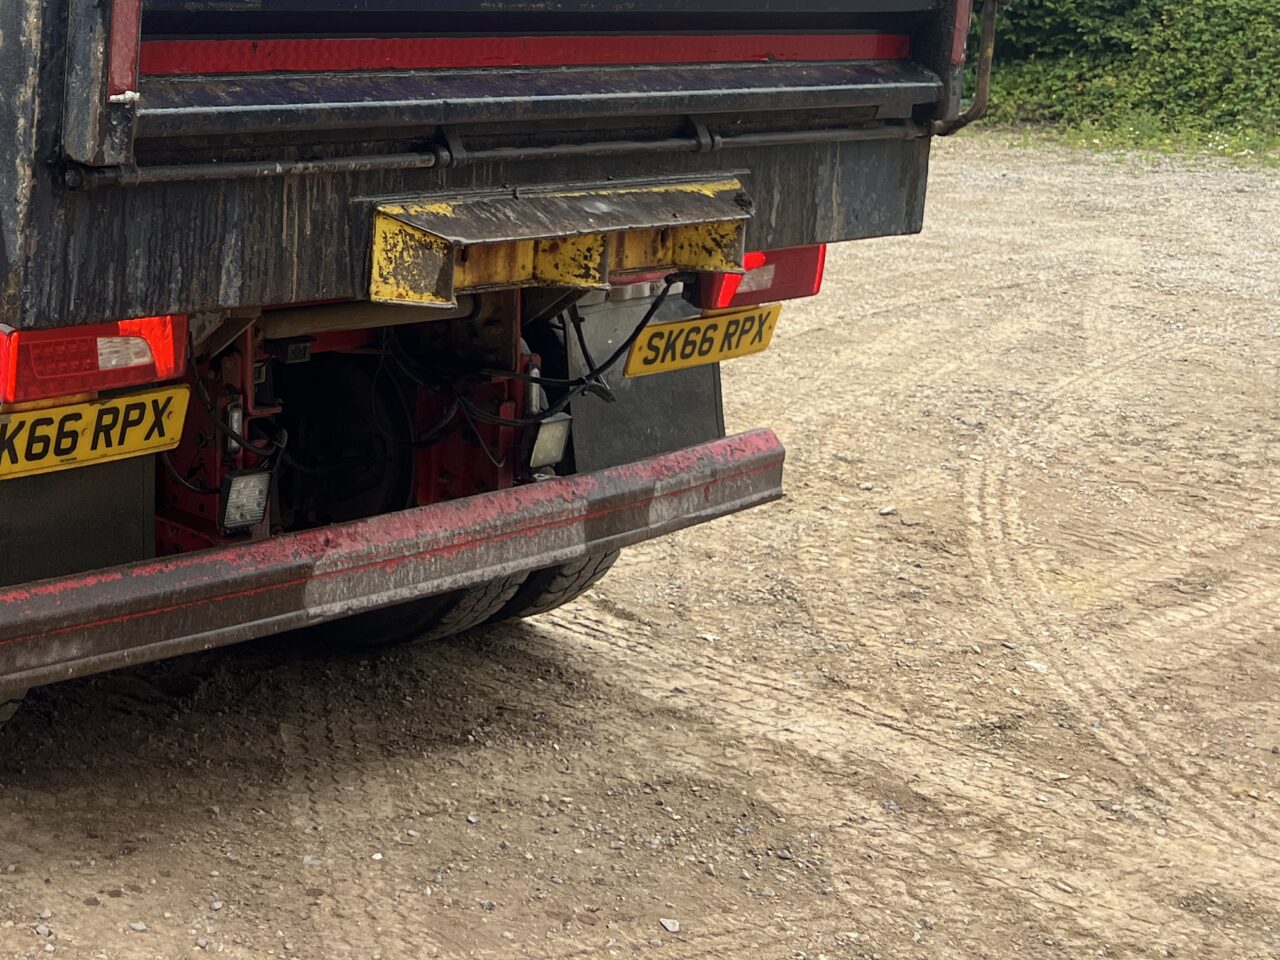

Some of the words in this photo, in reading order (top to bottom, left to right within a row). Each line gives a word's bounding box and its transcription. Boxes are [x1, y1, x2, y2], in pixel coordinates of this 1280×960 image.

[643, 323, 718, 365] SK66
[719, 311, 771, 352] RPX
[90, 397, 173, 451] RPX
